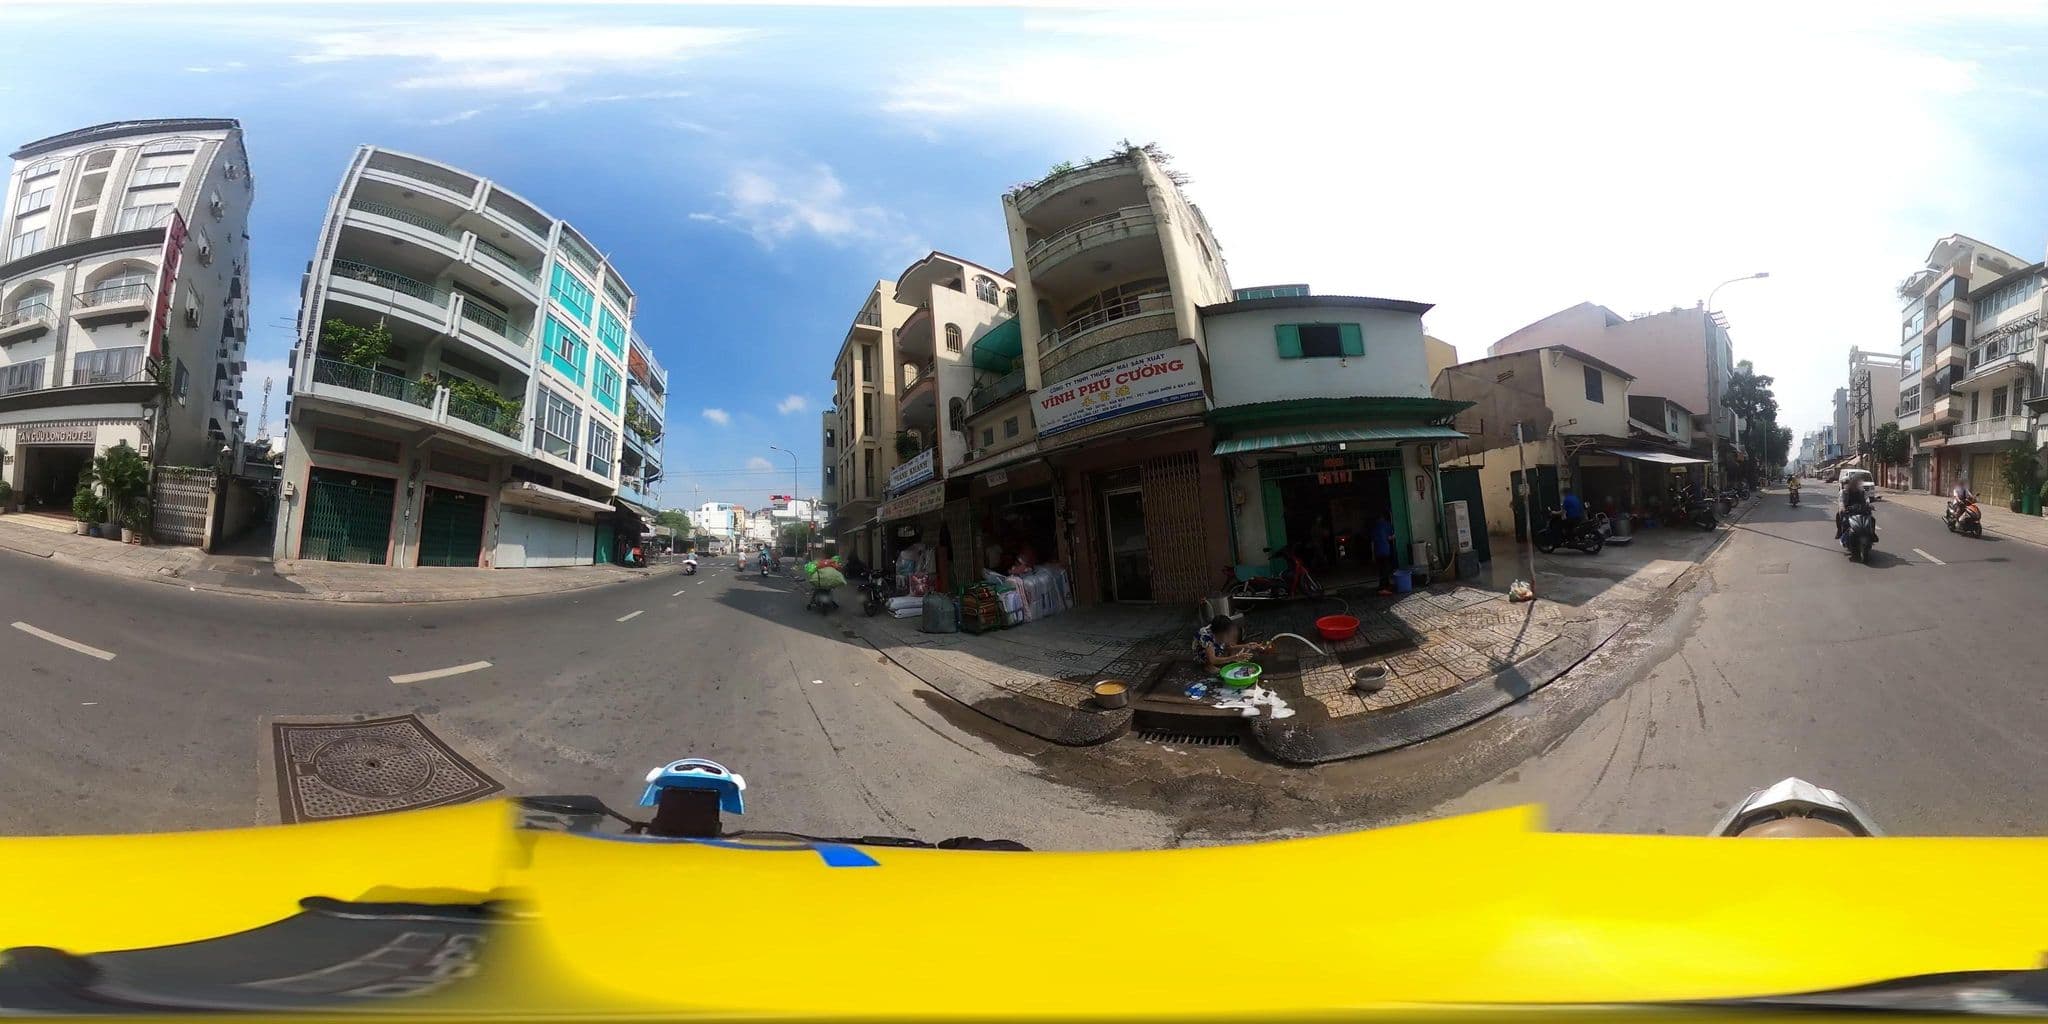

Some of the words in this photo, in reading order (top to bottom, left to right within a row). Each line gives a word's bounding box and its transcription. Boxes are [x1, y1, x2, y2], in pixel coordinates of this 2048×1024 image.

[1079, 375, 1111, 396] PHÚ
[1116, 359, 1184, 385] CƯỜNG
[45, 431, 66, 440] LONG
[67, 430, 93, 440] HOTEL
